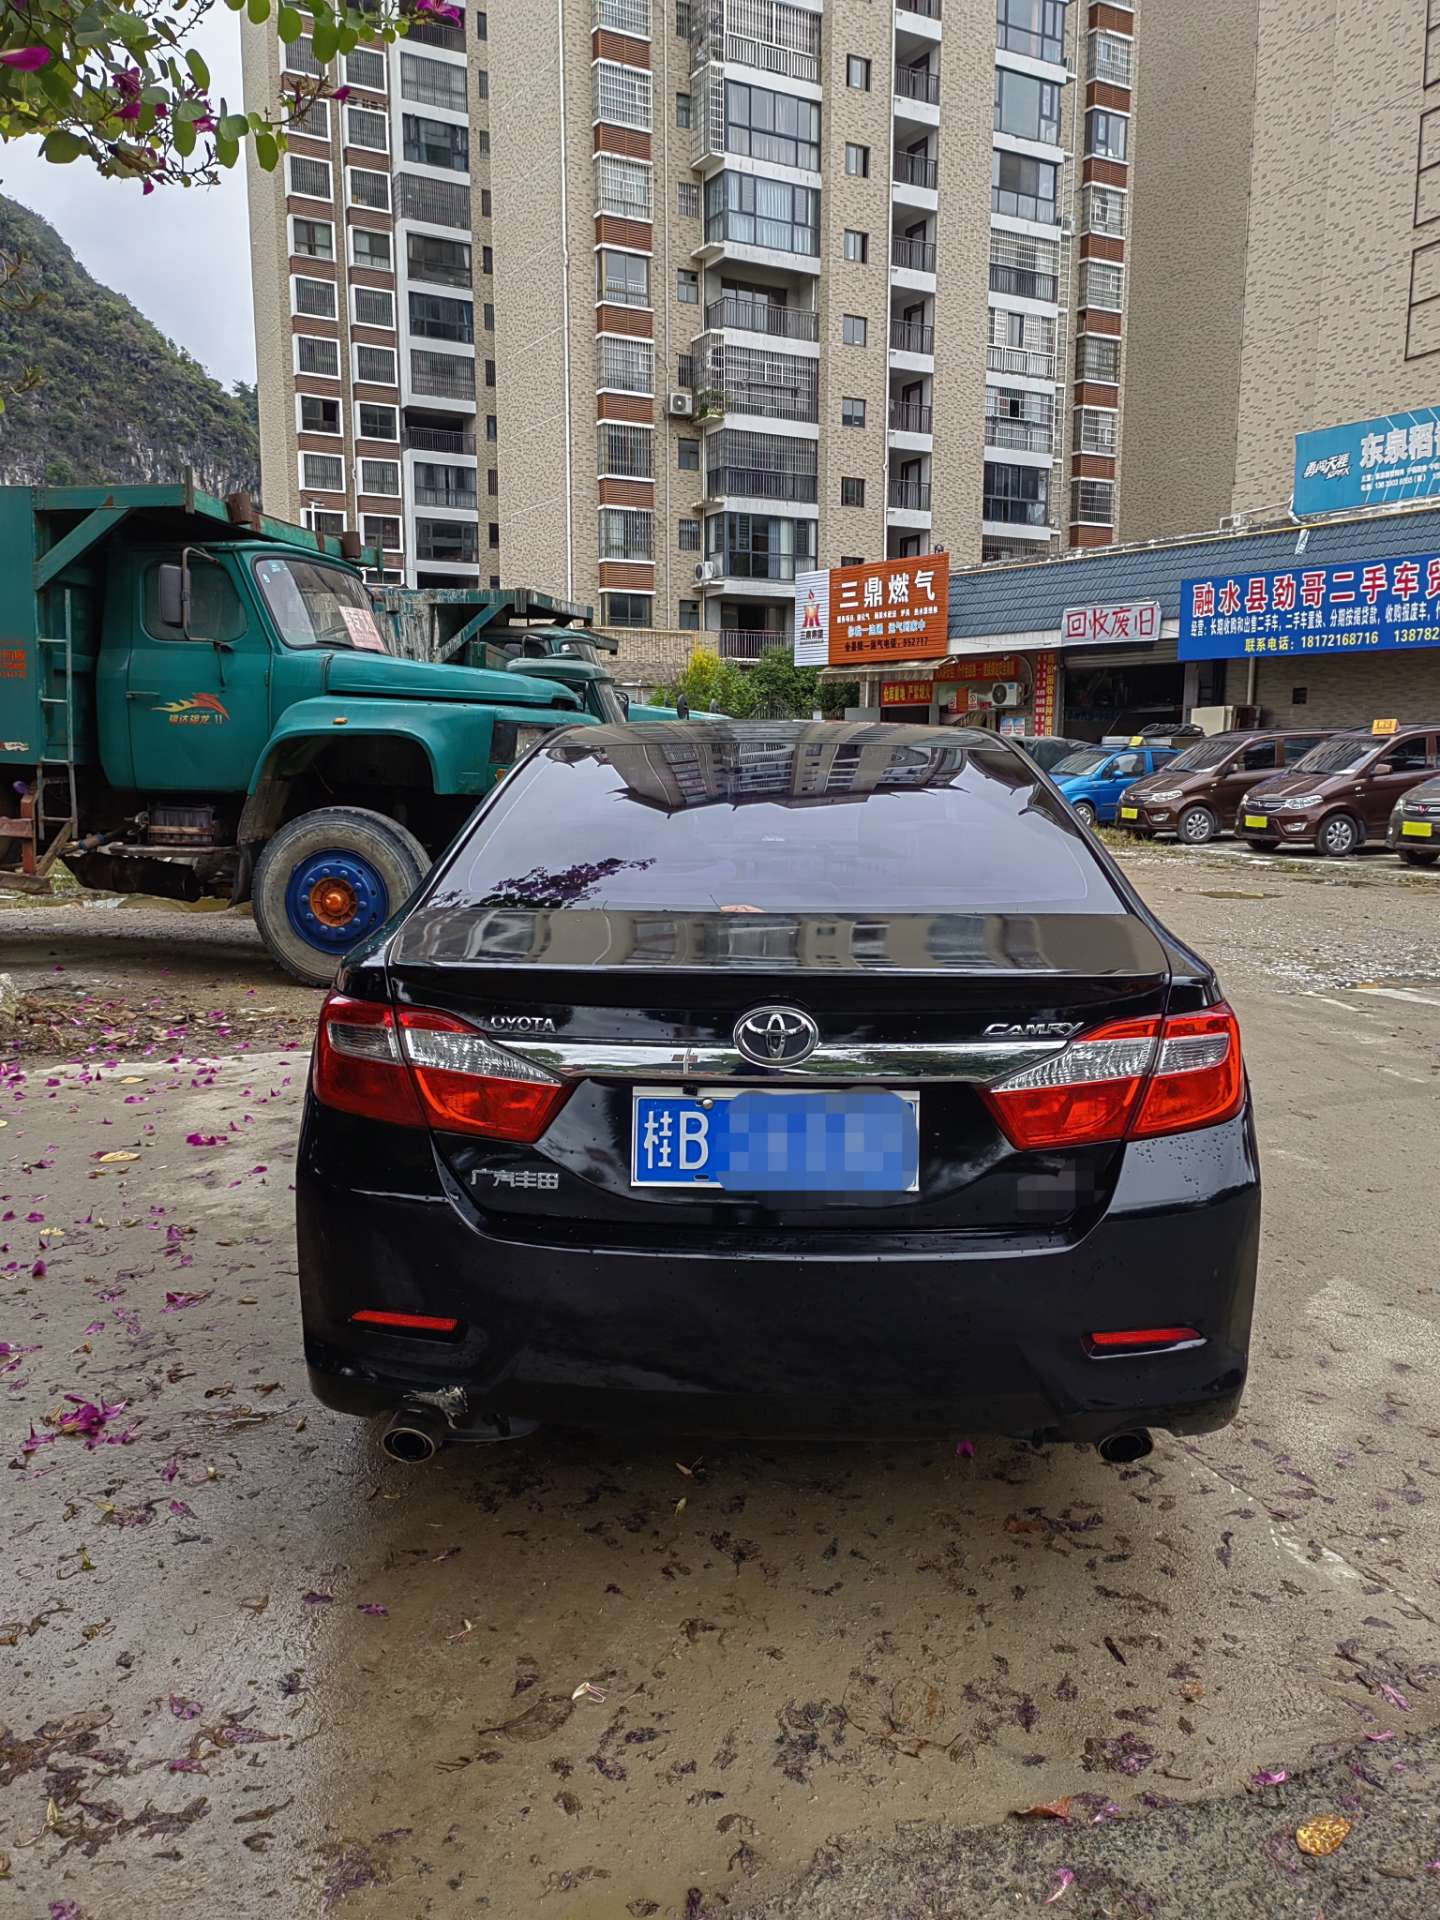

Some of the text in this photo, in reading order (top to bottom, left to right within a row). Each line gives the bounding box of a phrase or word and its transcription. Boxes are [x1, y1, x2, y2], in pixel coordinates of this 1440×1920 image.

[1360, 421, 1440, 468] 东泉稻
[839, 570, 936, 609] 三鼎燃气
[1065, 607, 1155, 640] 回收废旧
[480, 1016, 557, 1032] OYOTA
[983, 1022, 1084, 1036] CAMRY
[471, 1168, 559, 1189] 广汽丰田
